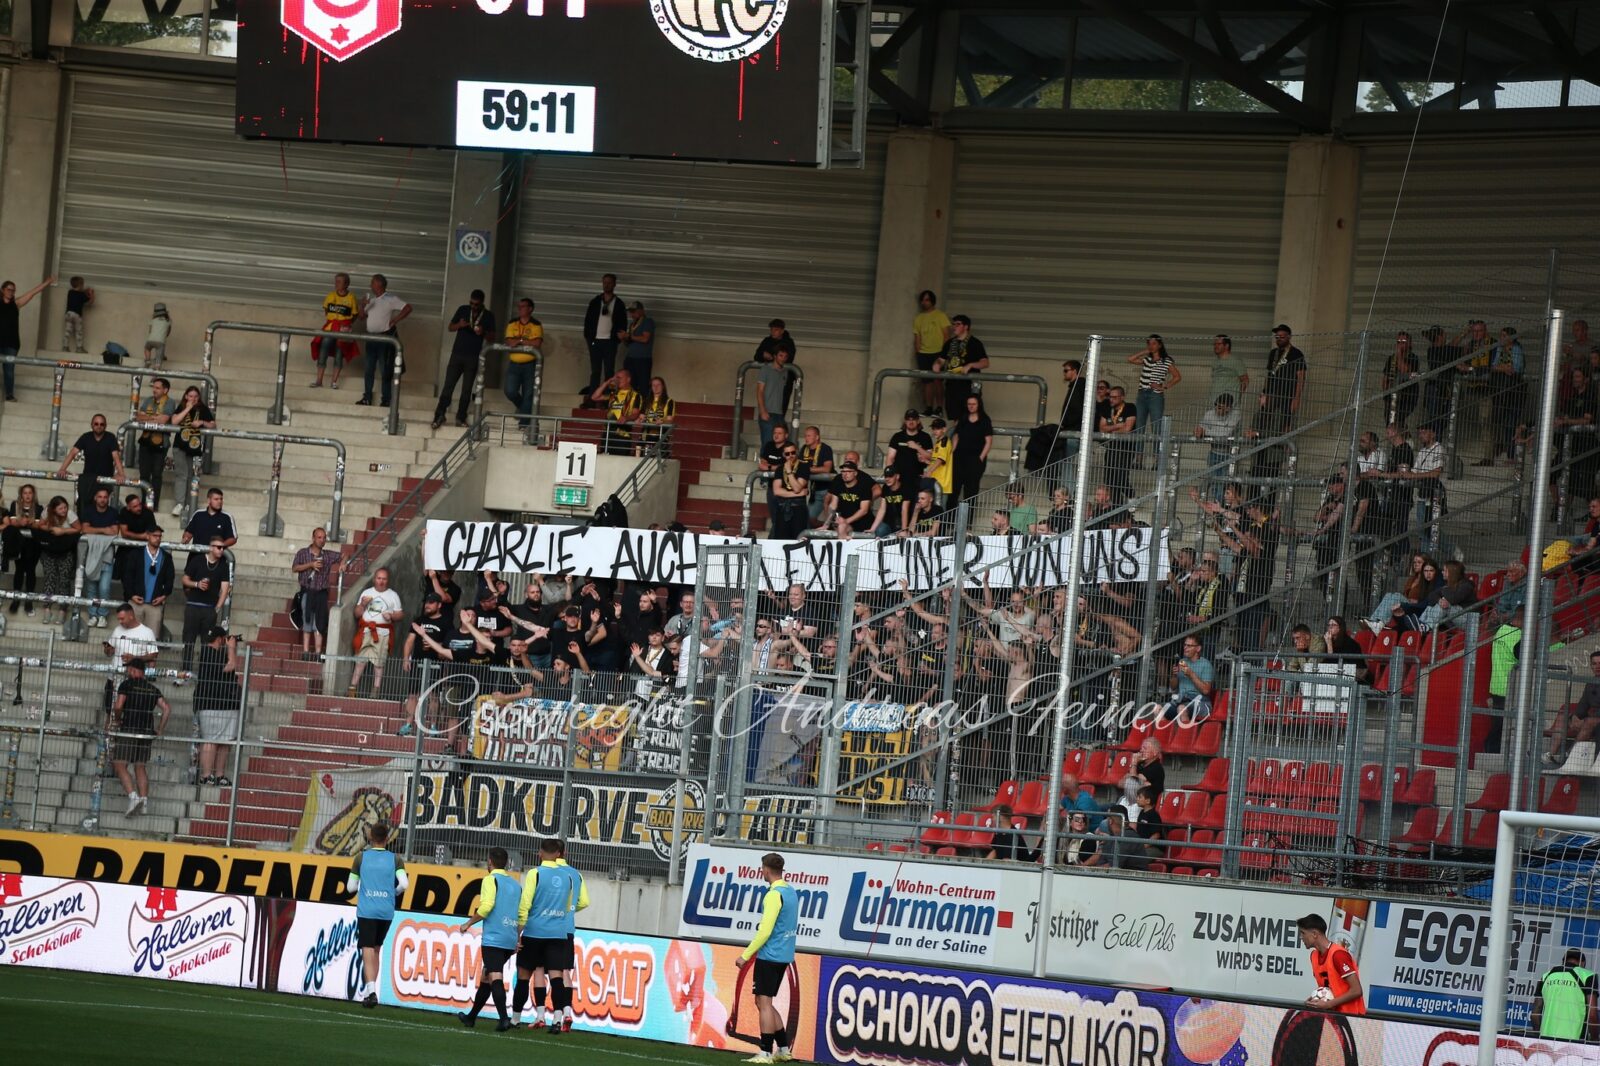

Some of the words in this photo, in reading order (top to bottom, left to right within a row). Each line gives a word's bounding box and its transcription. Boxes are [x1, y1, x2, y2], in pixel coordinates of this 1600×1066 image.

[482, 88, 576, 134] 59:11
[565, 452, 587, 477] 11
[443, 521, 594, 576] CHARLIE,
[610, 529, 699, 582] AUCH
[877, 533, 984, 593] EINER
[1007, 532, 1063, 588] VON
[1080, 527, 1143, 583] UNS
[405, 775, 649, 845] BADKURVE
[839, 871, 996, 945] Lührmann
[896, 879, 996, 900] Wohn-Centrum
[0, 892, 86, 955] alloren
[133, 906, 235, 973] Halloren
[736, 920, 752, 931] an
[1104, 913, 1144, 951] Edel
[1142, 913, 1177, 952] Pils
[11, 926, 83, 964] Schokolade
[167, 941, 232, 979] Schokolade
[895, 935, 912, 947] an
[916, 936, 939, 950] der
[942, 939, 988, 955] Saline
[1216, 950, 1263, 972] WIRD'S
[1266, 955, 1304, 977] EDEL.
[585, 955, 648, 1011] SALT
[835, 983, 962, 1052] SCHOKO
[966, 999, 989, 1056] &
[1000, 1007, 1160, 1066] EIERLIKÖR
